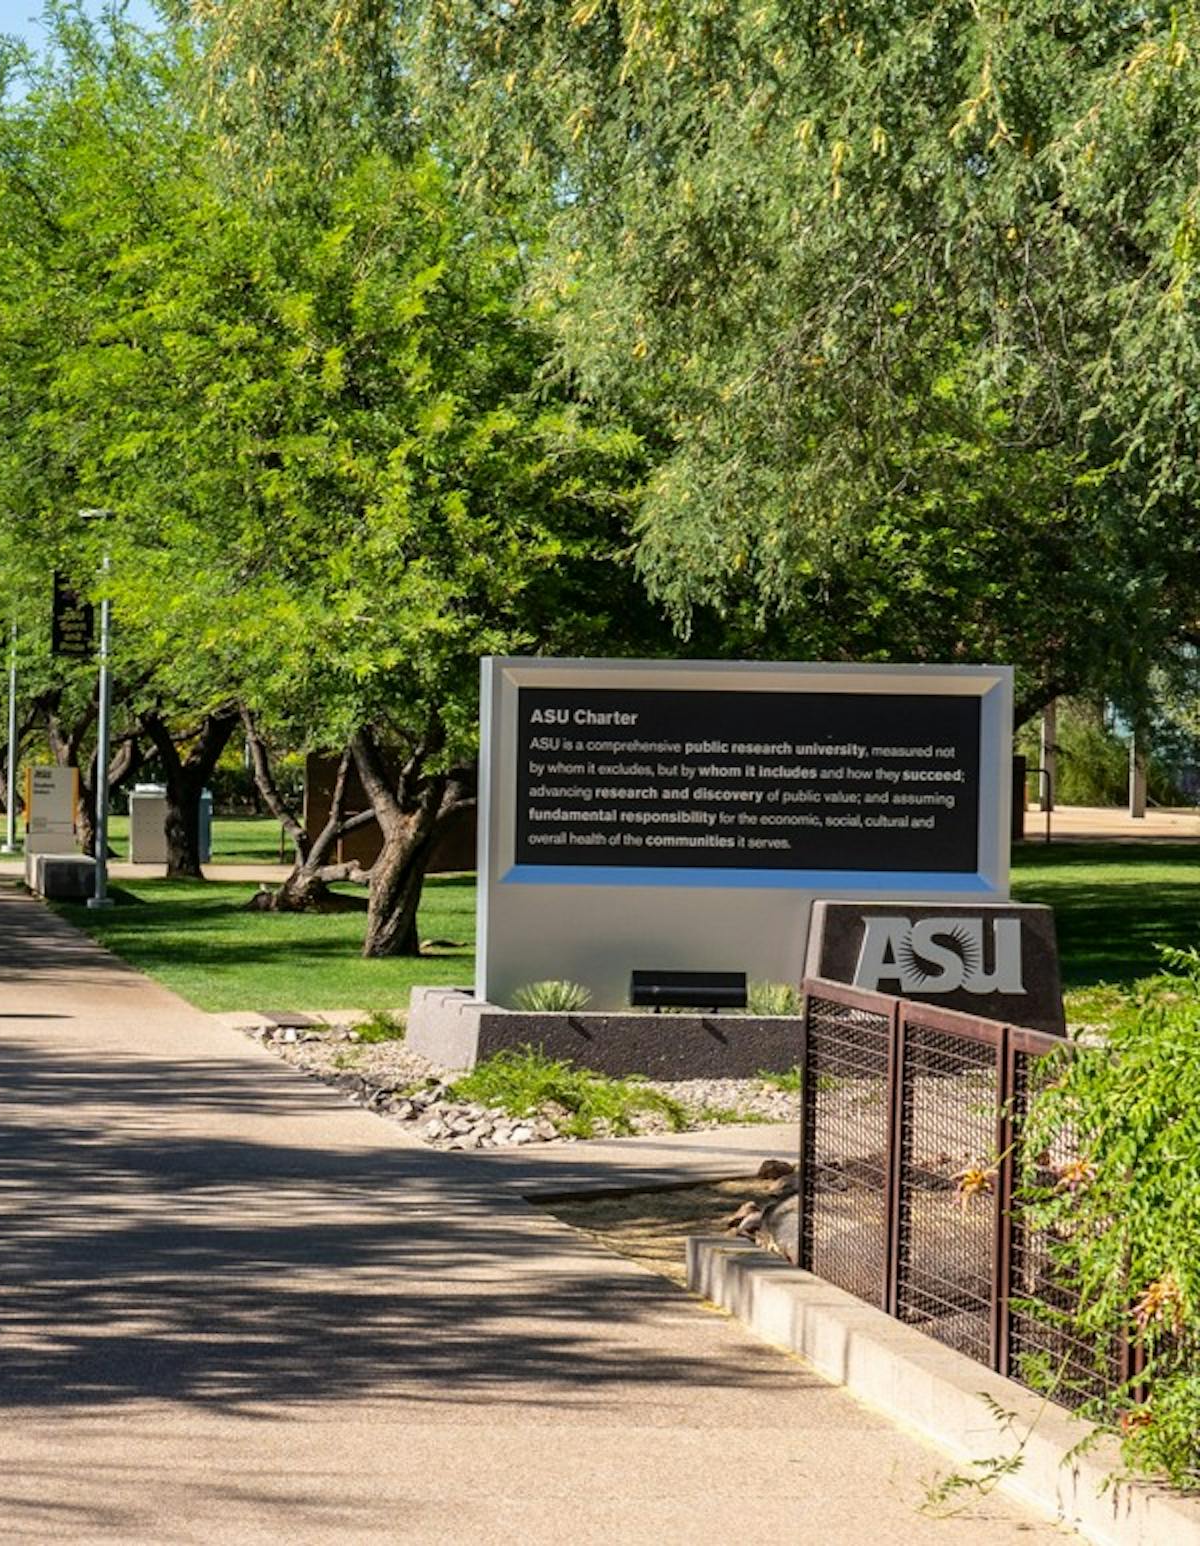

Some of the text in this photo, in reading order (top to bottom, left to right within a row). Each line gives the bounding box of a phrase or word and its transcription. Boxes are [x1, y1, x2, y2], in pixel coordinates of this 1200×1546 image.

[530, 709, 638, 725] ASU Charter
[529, 737, 956, 758] ASU is a comprehensive public research university, measured not
[529, 761, 966, 783] by whom it excludes, but by whom it includes and how they succeed;
[529, 785, 955, 808] advancing research and discovery of public value; and assuming
[528, 807, 935, 828] fundamental responsibility for the economic, social, cultural and
[528, 832, 791, 849] overall health of the communities it serves.
[853, 917, 1027, 995] ASU
